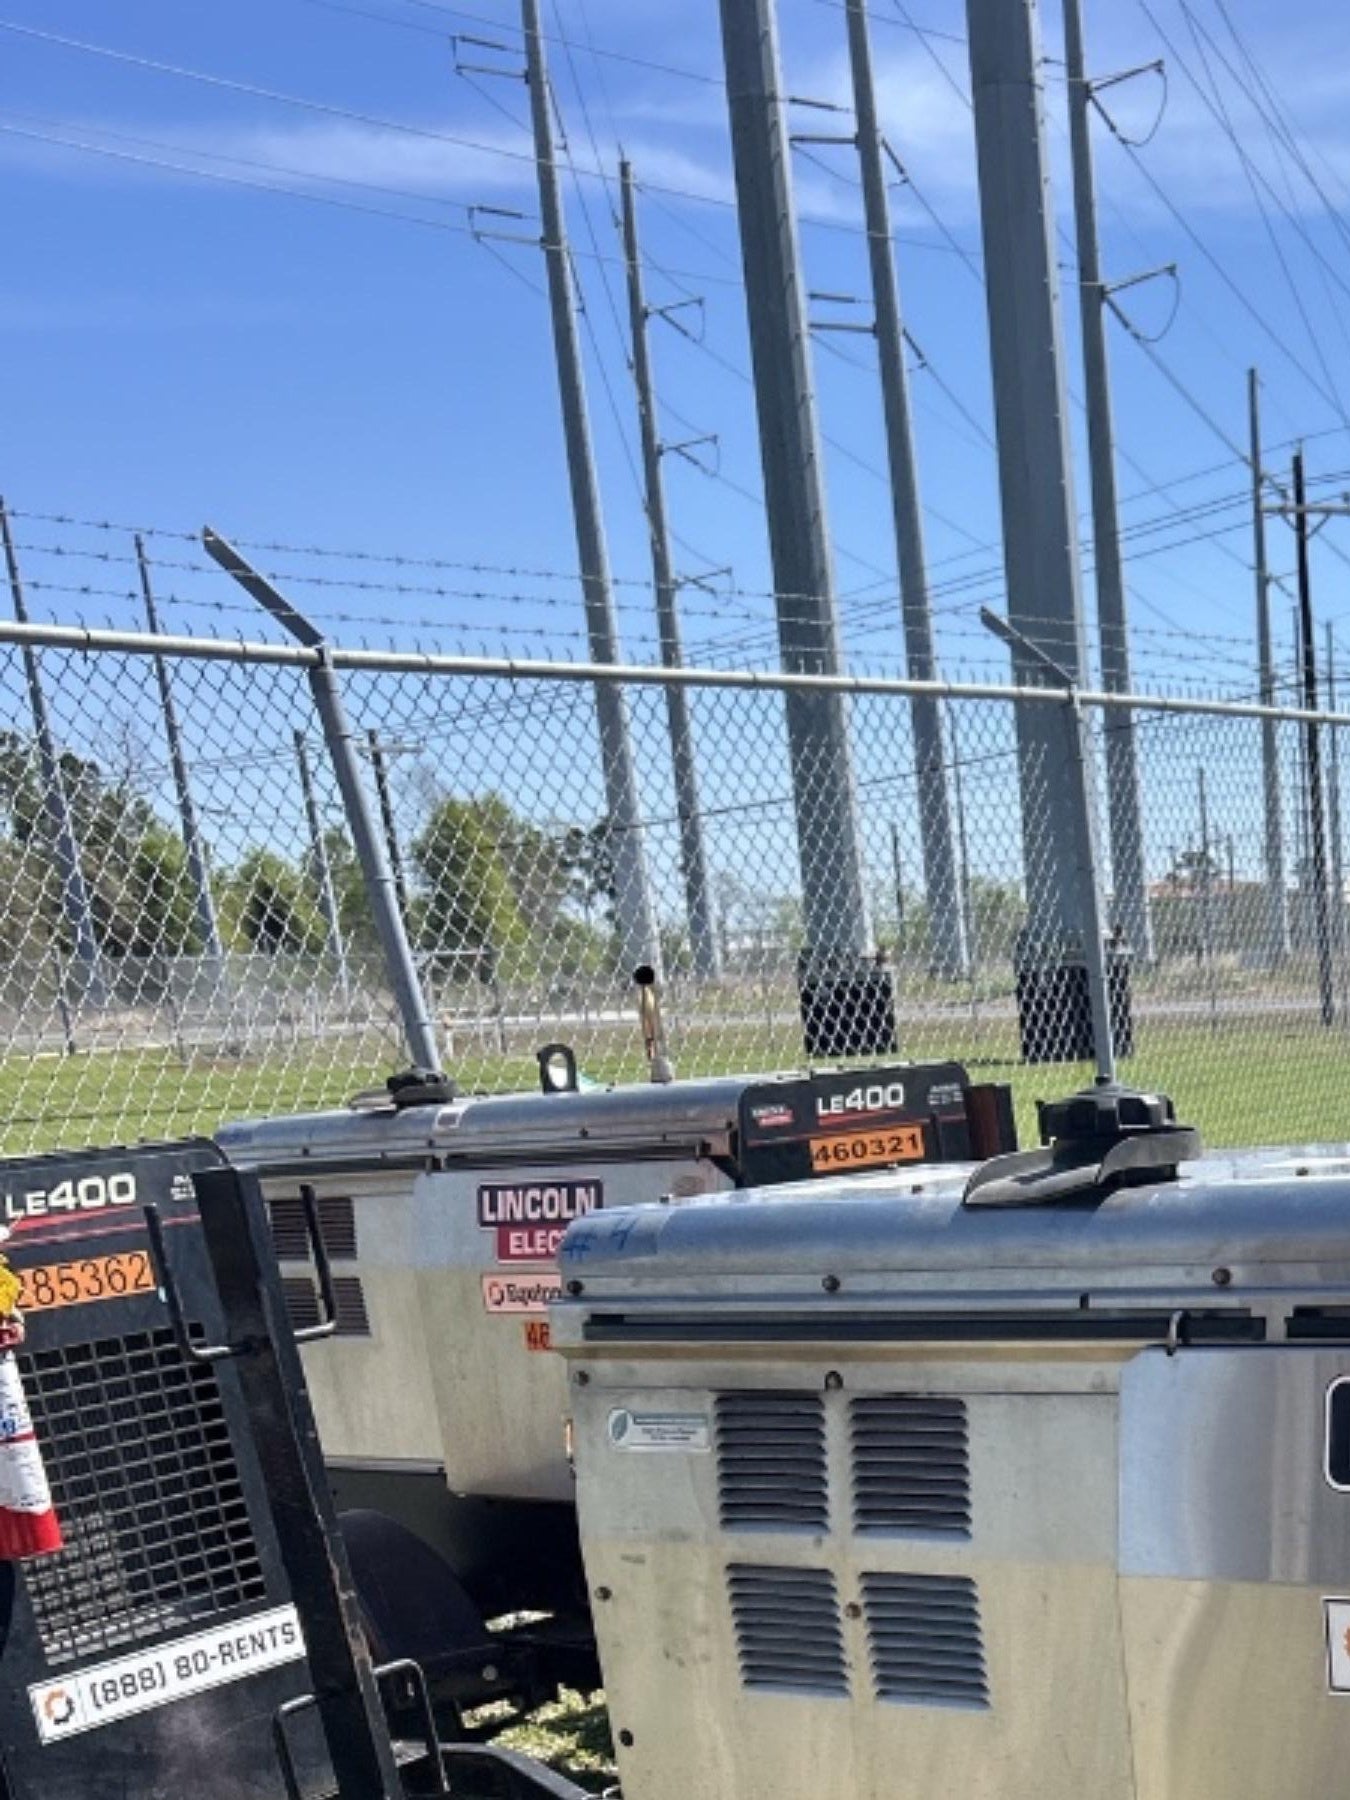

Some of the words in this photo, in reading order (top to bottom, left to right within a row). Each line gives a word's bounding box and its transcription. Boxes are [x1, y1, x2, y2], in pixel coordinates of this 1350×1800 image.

[817, 1083, 904, 1114] LE400
[814, 1134, 918, 1163] 460321
[5, 1171, 136, 1218] LE400
[482, 1186, 595, 1222] LINCOLN
[509, 1230, 568, 1256] ELEC
[90, 1660, 167, 1709] (888)
[174, 1622, 297, 1680] 80-RENTS
